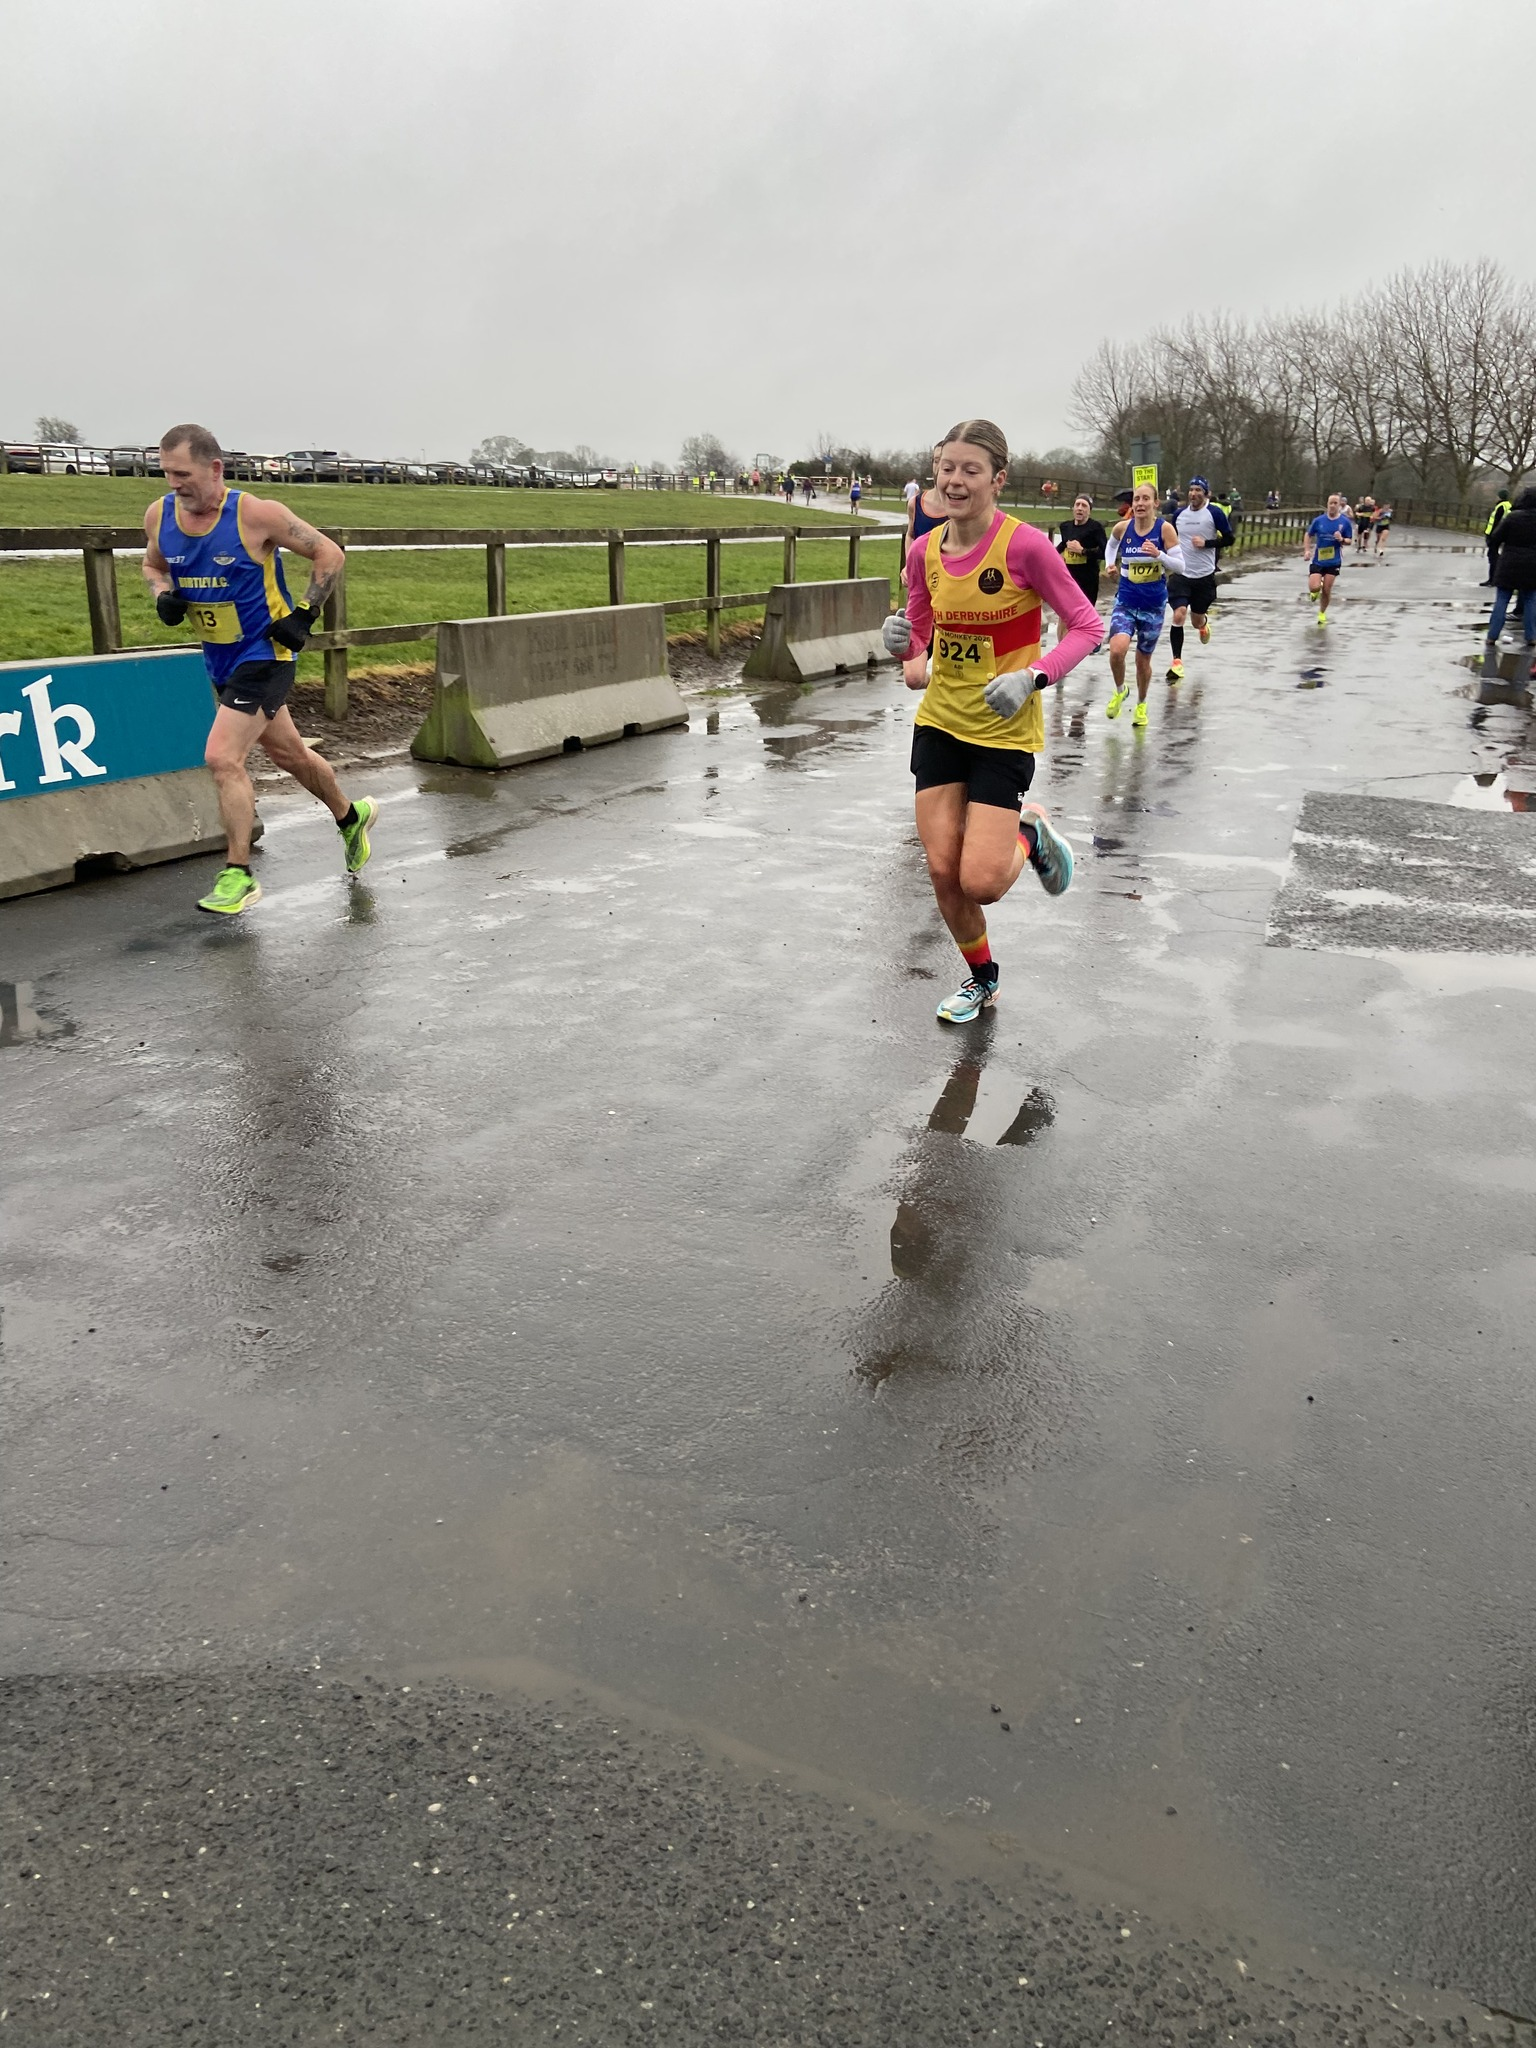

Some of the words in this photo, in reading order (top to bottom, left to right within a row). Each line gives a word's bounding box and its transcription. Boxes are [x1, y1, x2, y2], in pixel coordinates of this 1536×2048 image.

[1132, 565, 1159, 575] 1074
[196, 610, 217, 628] 13
[946, 605, 1018, 622] DERBYSHIRE
[944, 631, 972, 641] MONKEY
[940, 638, 981, 663] 924
